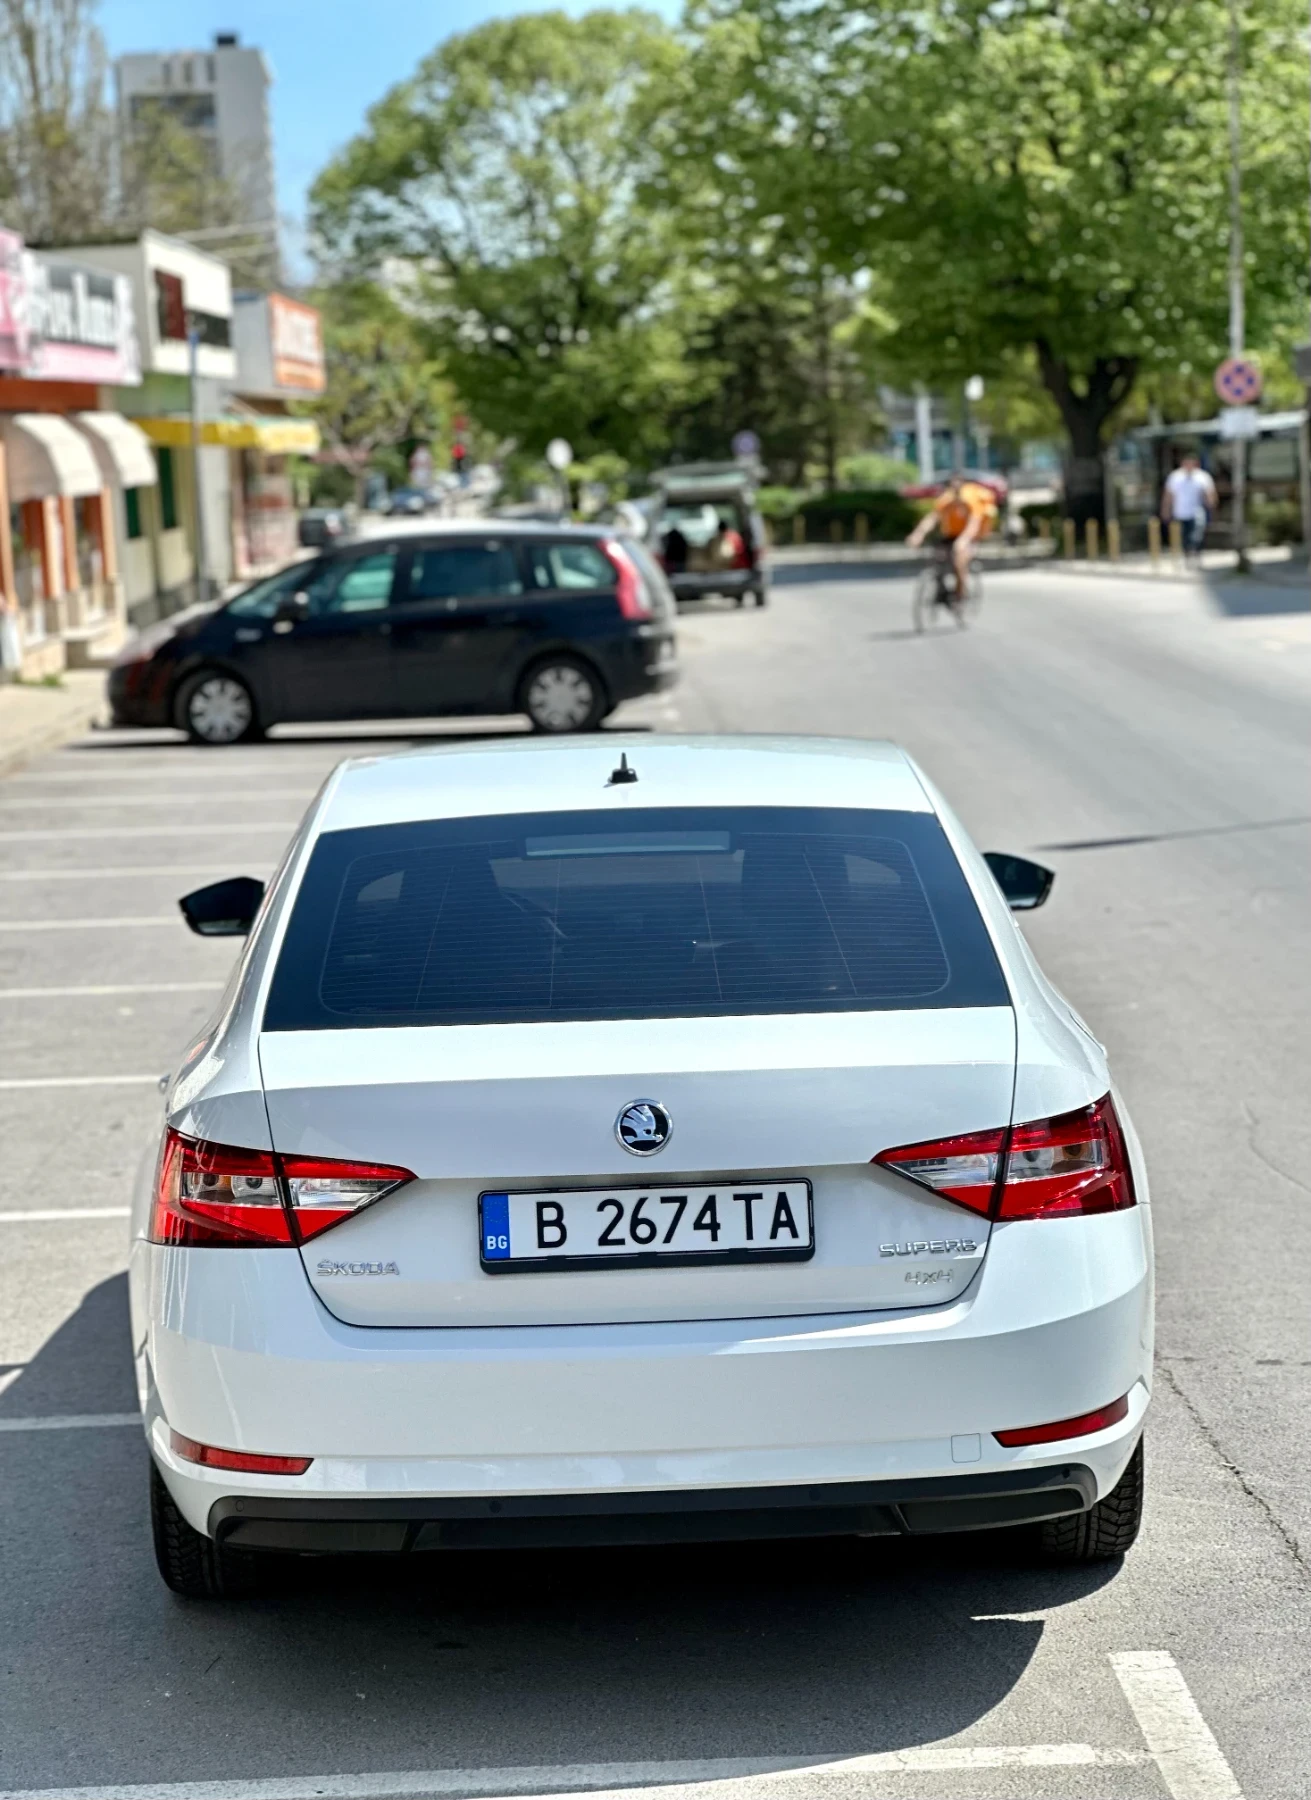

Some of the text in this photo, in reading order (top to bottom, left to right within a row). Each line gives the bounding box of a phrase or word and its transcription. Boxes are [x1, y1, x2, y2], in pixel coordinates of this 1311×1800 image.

[536, 1191, 799, 1249] B 2674 TA
[486, 1235, 508, 1250] BG
[879, 1238, 977, 1258] SUPERB
